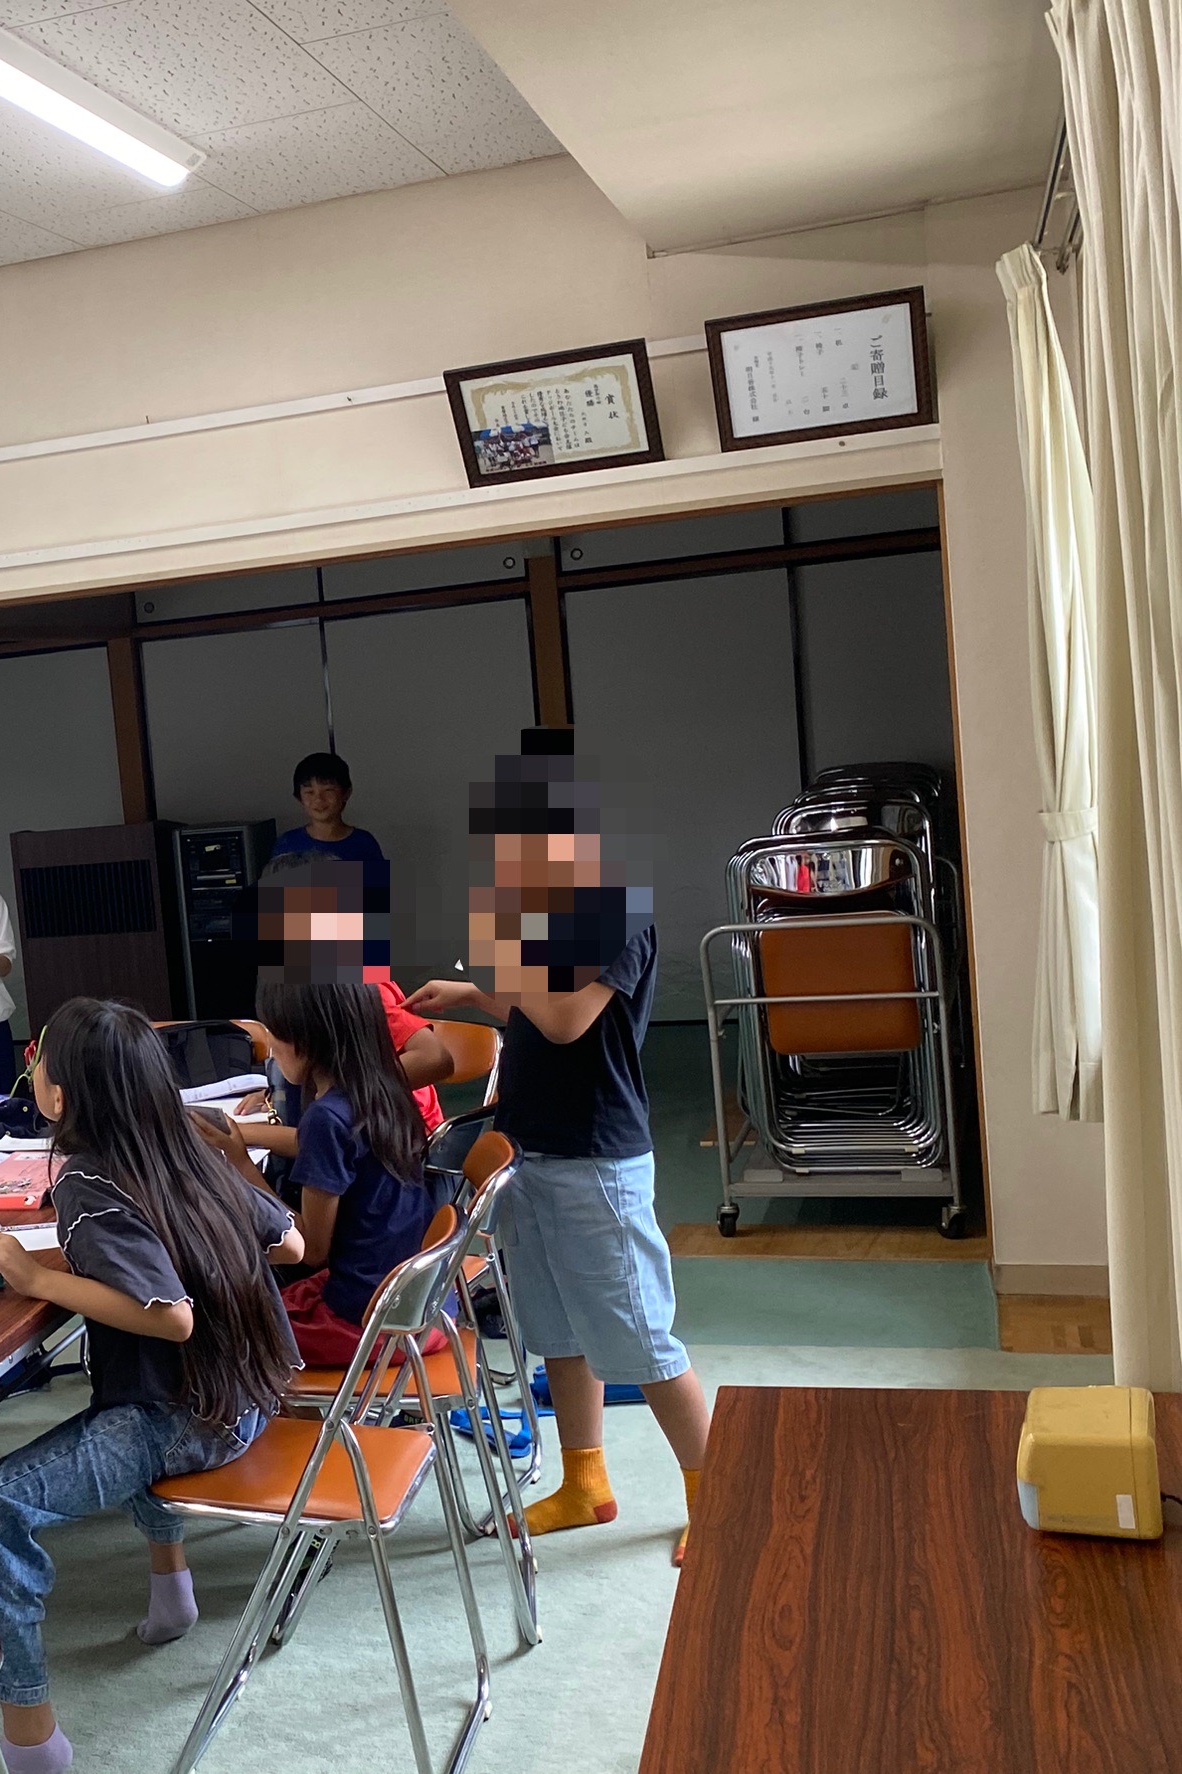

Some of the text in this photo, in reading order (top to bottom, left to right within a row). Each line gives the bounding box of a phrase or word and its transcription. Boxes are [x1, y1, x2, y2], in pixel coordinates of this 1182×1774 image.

[870, 334, 888, 400] ご寄贈目録
[605, 393, 619, 419] 賞状
